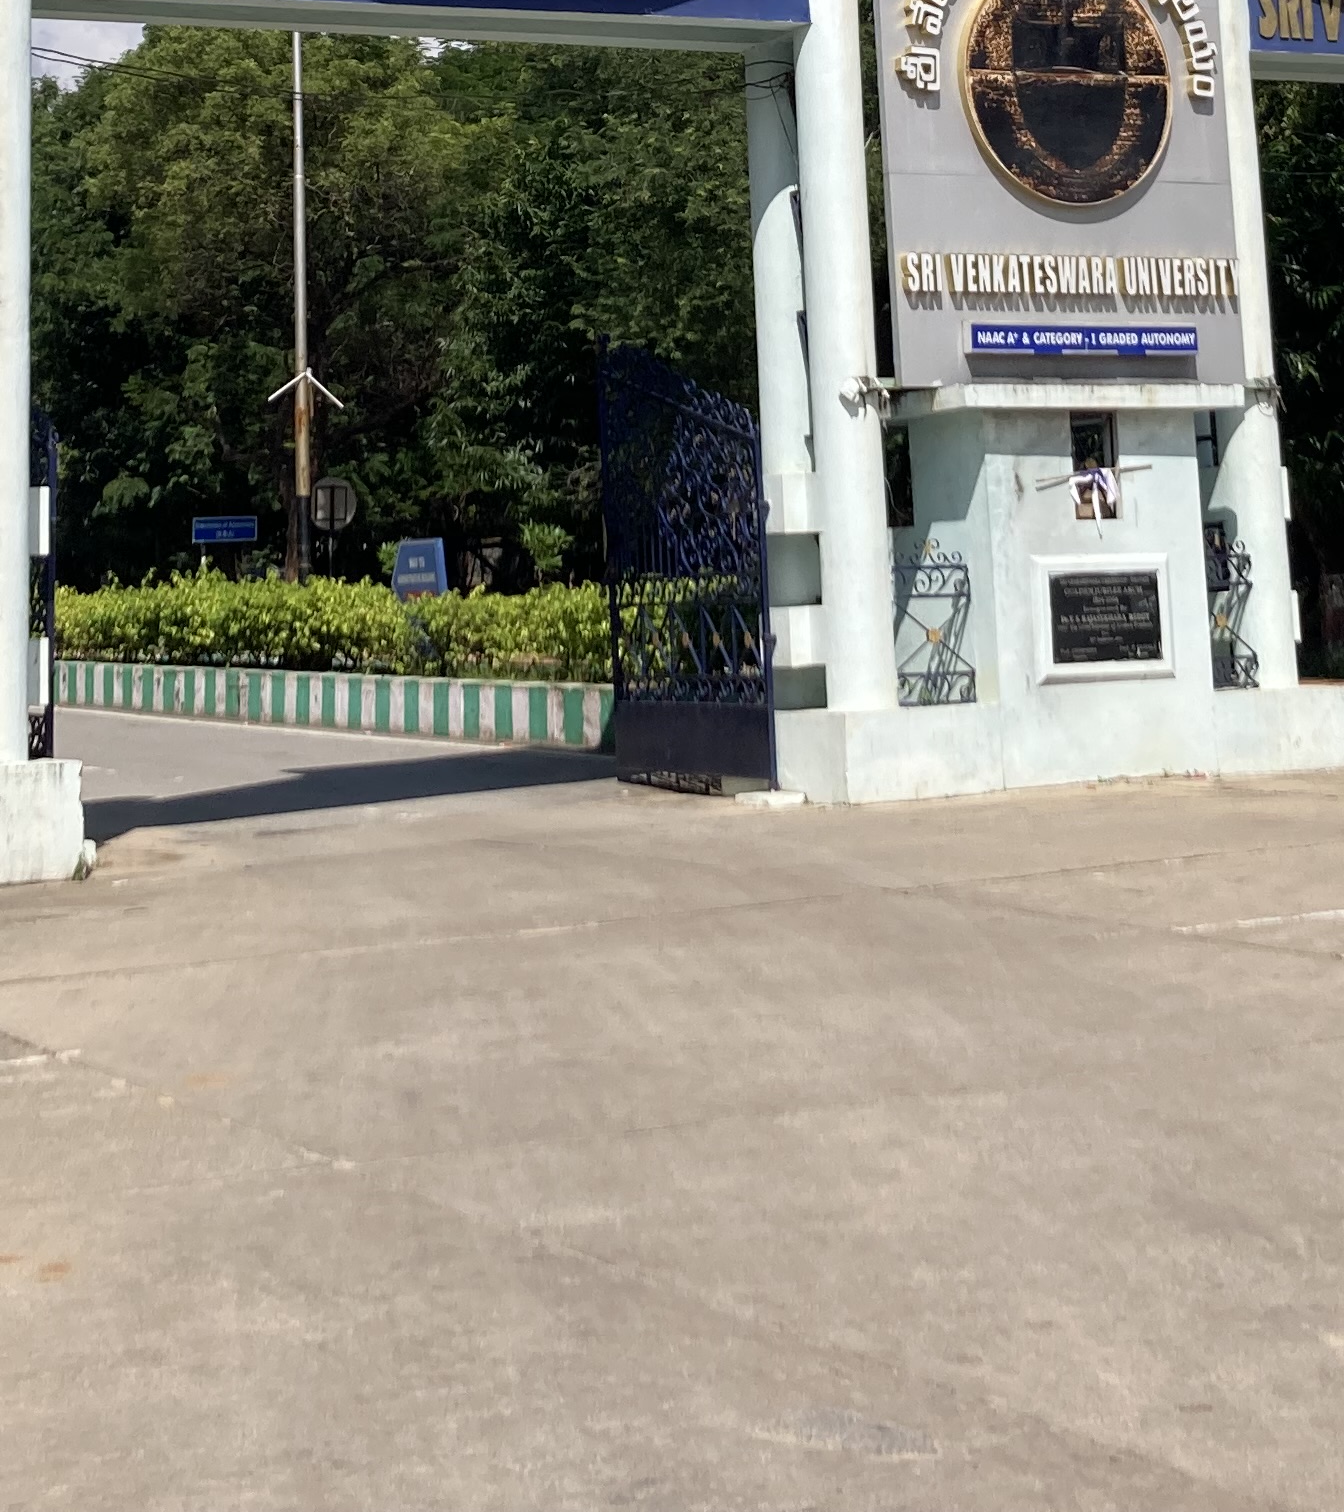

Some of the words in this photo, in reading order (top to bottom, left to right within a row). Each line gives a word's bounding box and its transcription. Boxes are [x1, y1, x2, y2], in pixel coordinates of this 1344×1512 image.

[900, 46, 940, 91] శ్రీ
[906, 252, 943, 292] SRI
[949, 253, 1119, 296] VENKATESWARA
[1122, 256, 1239, 297] UNIVERSITY
[977, 331, 1006, 345] NAAC
[1022, 332, 1030, 345] &
[1033, 332, 1083, 346] CATEGORY
[1099, 333, 1138, 346] GRADED
[1141, 333, 1195, 346] AUTONOMY
